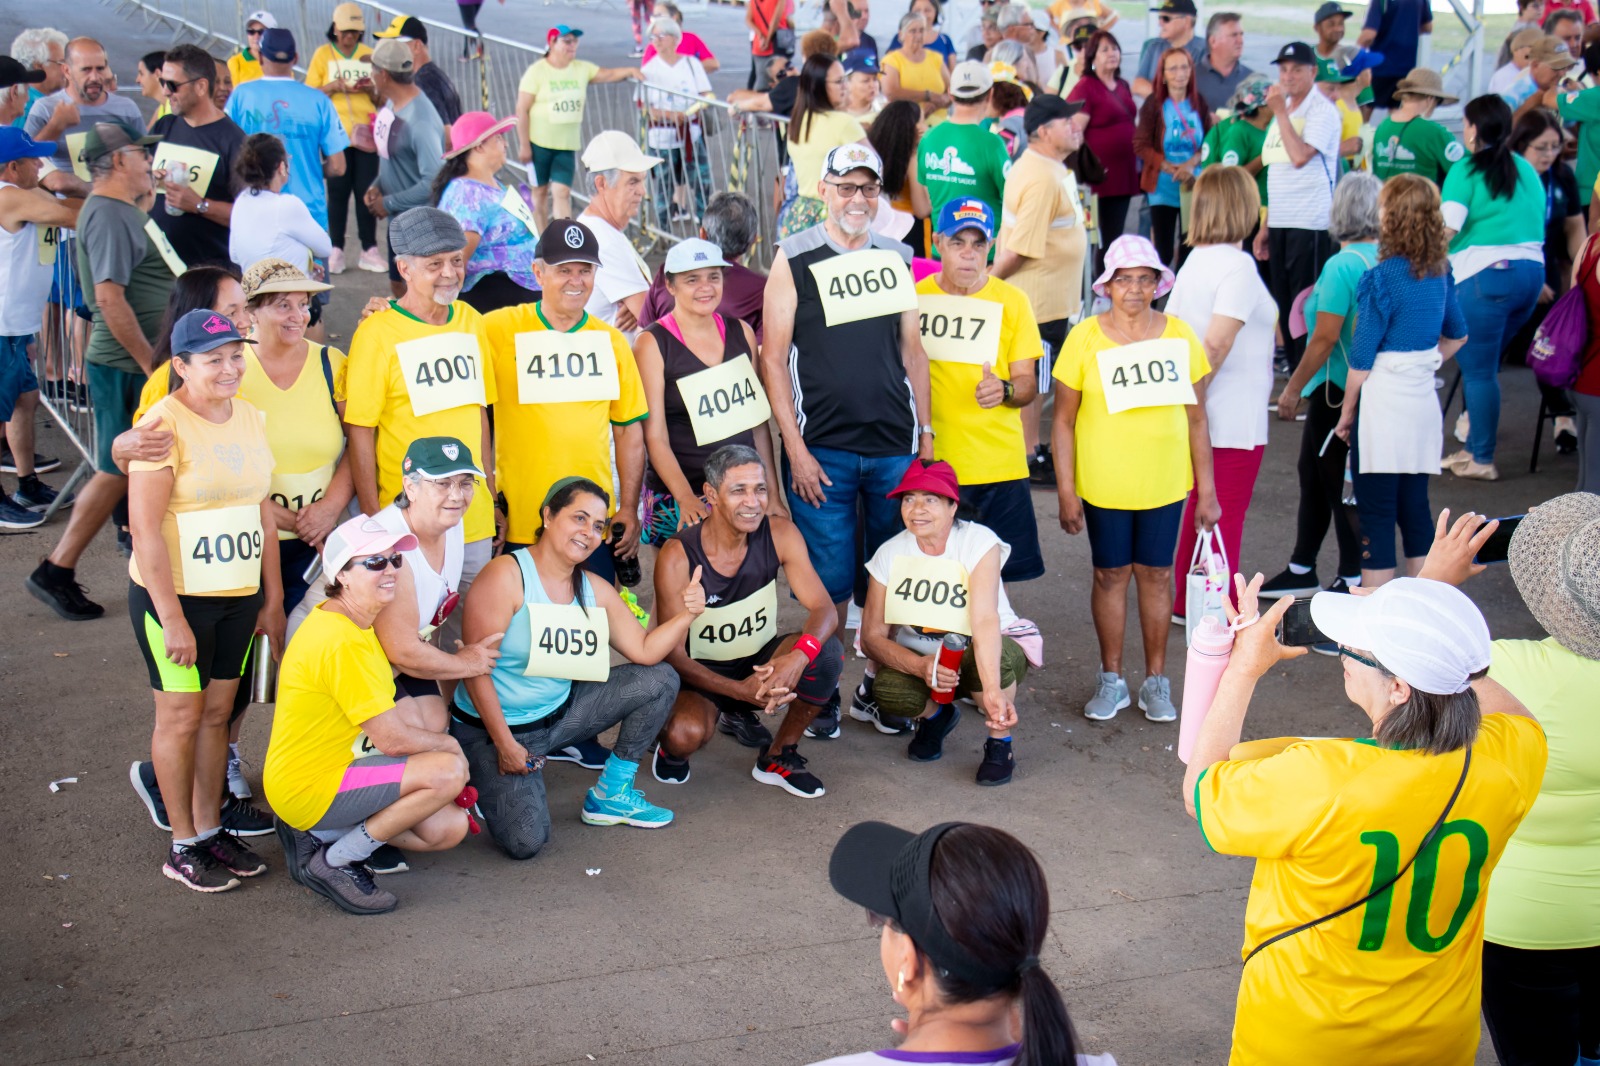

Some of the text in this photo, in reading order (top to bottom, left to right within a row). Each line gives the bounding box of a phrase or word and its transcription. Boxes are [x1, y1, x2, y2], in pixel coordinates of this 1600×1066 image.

[829, 267, 898, 300] 4060
[918, 312, 987, 341] 4017
[415, 354, 477, 388] 4007
[526, 351, 603, 379] 4101
[1111, 359, 1180, 388] 4103
[698, 377, 756, 418] 4044
[192, 530, 261, 564] 4009
[894, 577, 967, 608] 4008
[538, 626, 598, 656] 4059
[698, 606, 767, 644] 4045
[1357, 818, 1489, 953] 10
